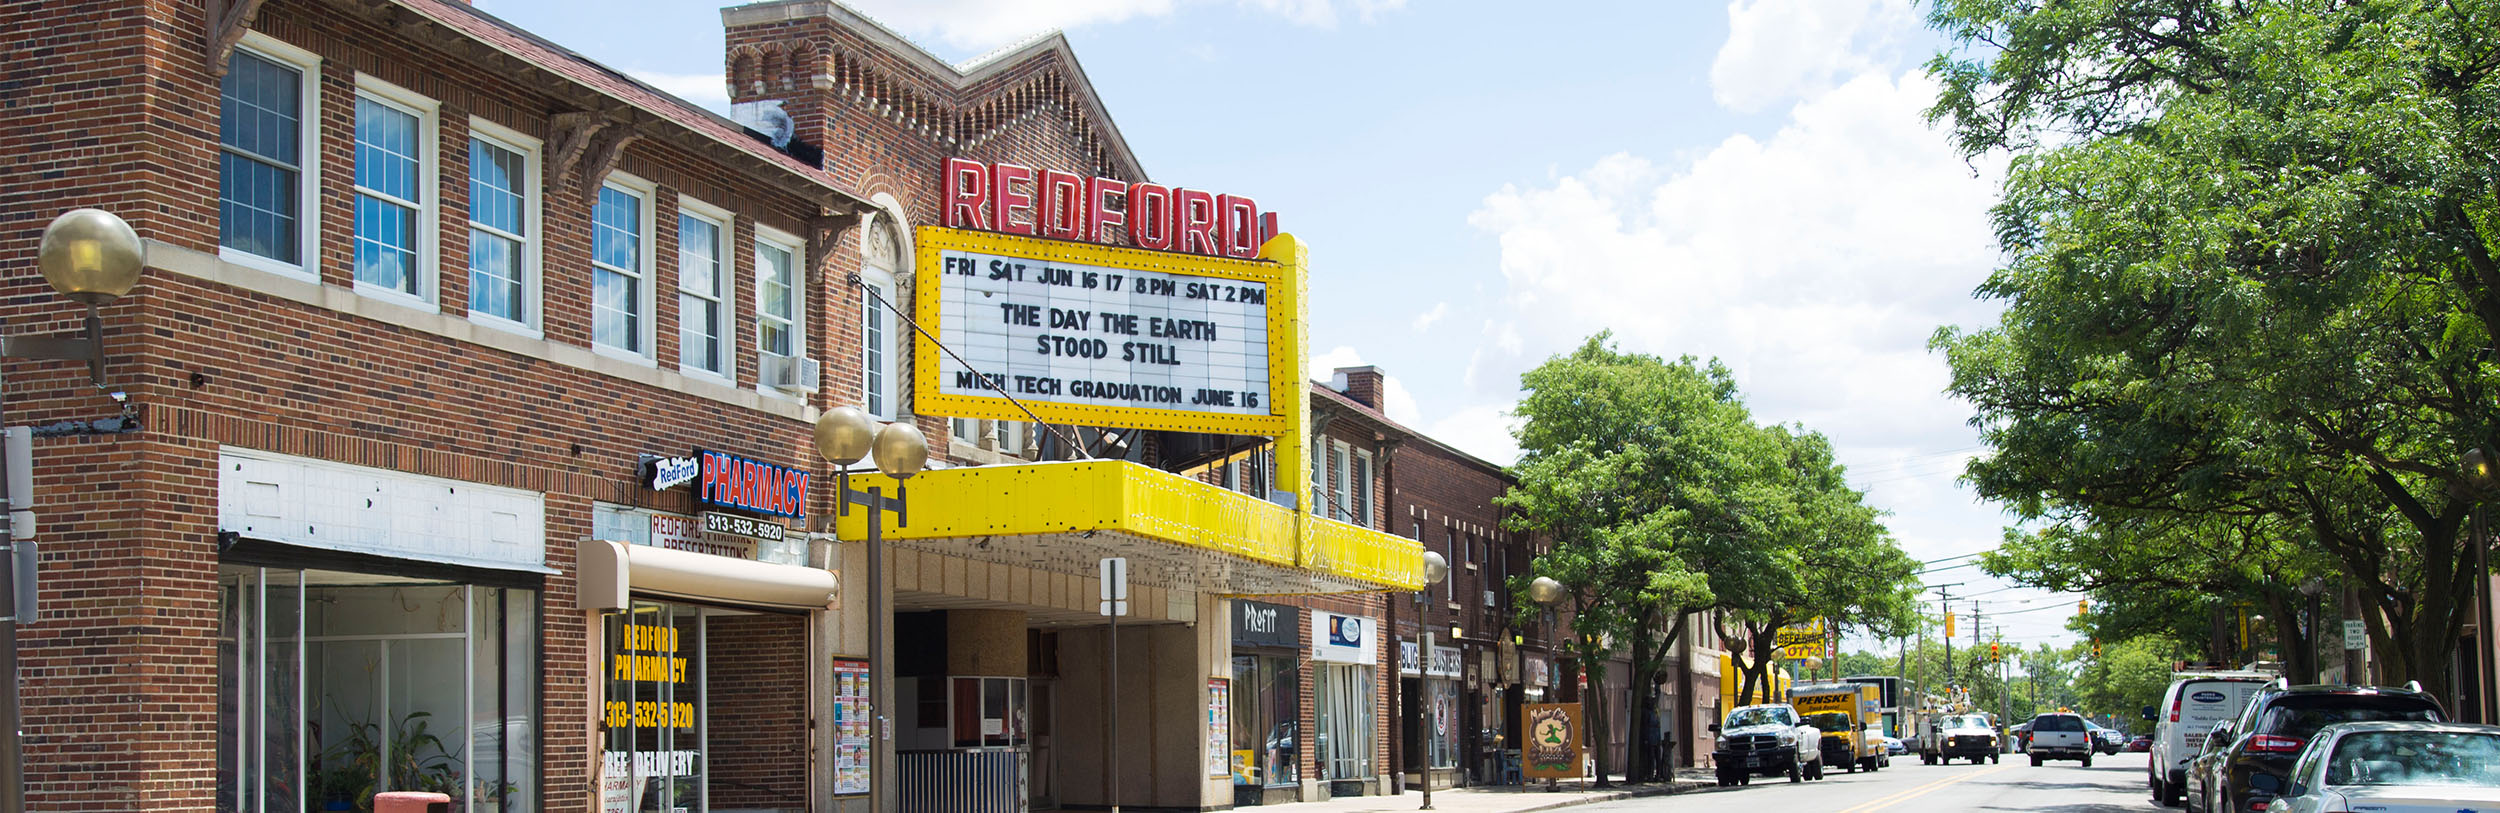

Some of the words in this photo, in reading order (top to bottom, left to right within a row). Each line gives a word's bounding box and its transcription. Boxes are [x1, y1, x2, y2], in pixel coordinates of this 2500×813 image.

[941, 157, 1260, 260] REDFORD
[945, 257, 976, 276] FRI
[988, 260, 1026, 282] SAT
[1037, 267, 1073, 287] JUN
[1082, 271, 1098, 289] 16
[1106, 274, 1123, 292] 17
[1186, 282, 1220, 302] SAT
[1225, 285, 1236, 302] 2
[1240, 287, 1266, 305] PM
[1001, 303, 1041, 328] THE
[1050, 308, 1091, 331] DAY
[1100, 312, 1139, 336] THE
[1150, 317, 1217, 342] EARTH
[1037, 334, 1108, 360] STOOD
[1123, 342, 1181, 366] STILL
[956, 371, 1005, 392] MICH
[1015, 375, 1062, 397] TECH
[1070, 380, 1182, 404] GRADUATION
[1191, 388, 1235, 408] JUNE
[1240, 391, 1259, 408] 16
[701, 450, 810, 518] PHARMACY
[708, 515, 782, 540] 313-532-5920
[624, 624, 678, 652] REDFORD
[1784, 646, 1823, 657] OTTO
[614, 655, 687, 683] PHARMACY
[1402, 645, 1420, 670] BLIG
[1797, 694, 1851, 706] PENSKE
[606, 701, 693, 728] 313-532-5920
[604, 751, 628, 776] REE
[635, 751, 694, 776] DELIVERY
